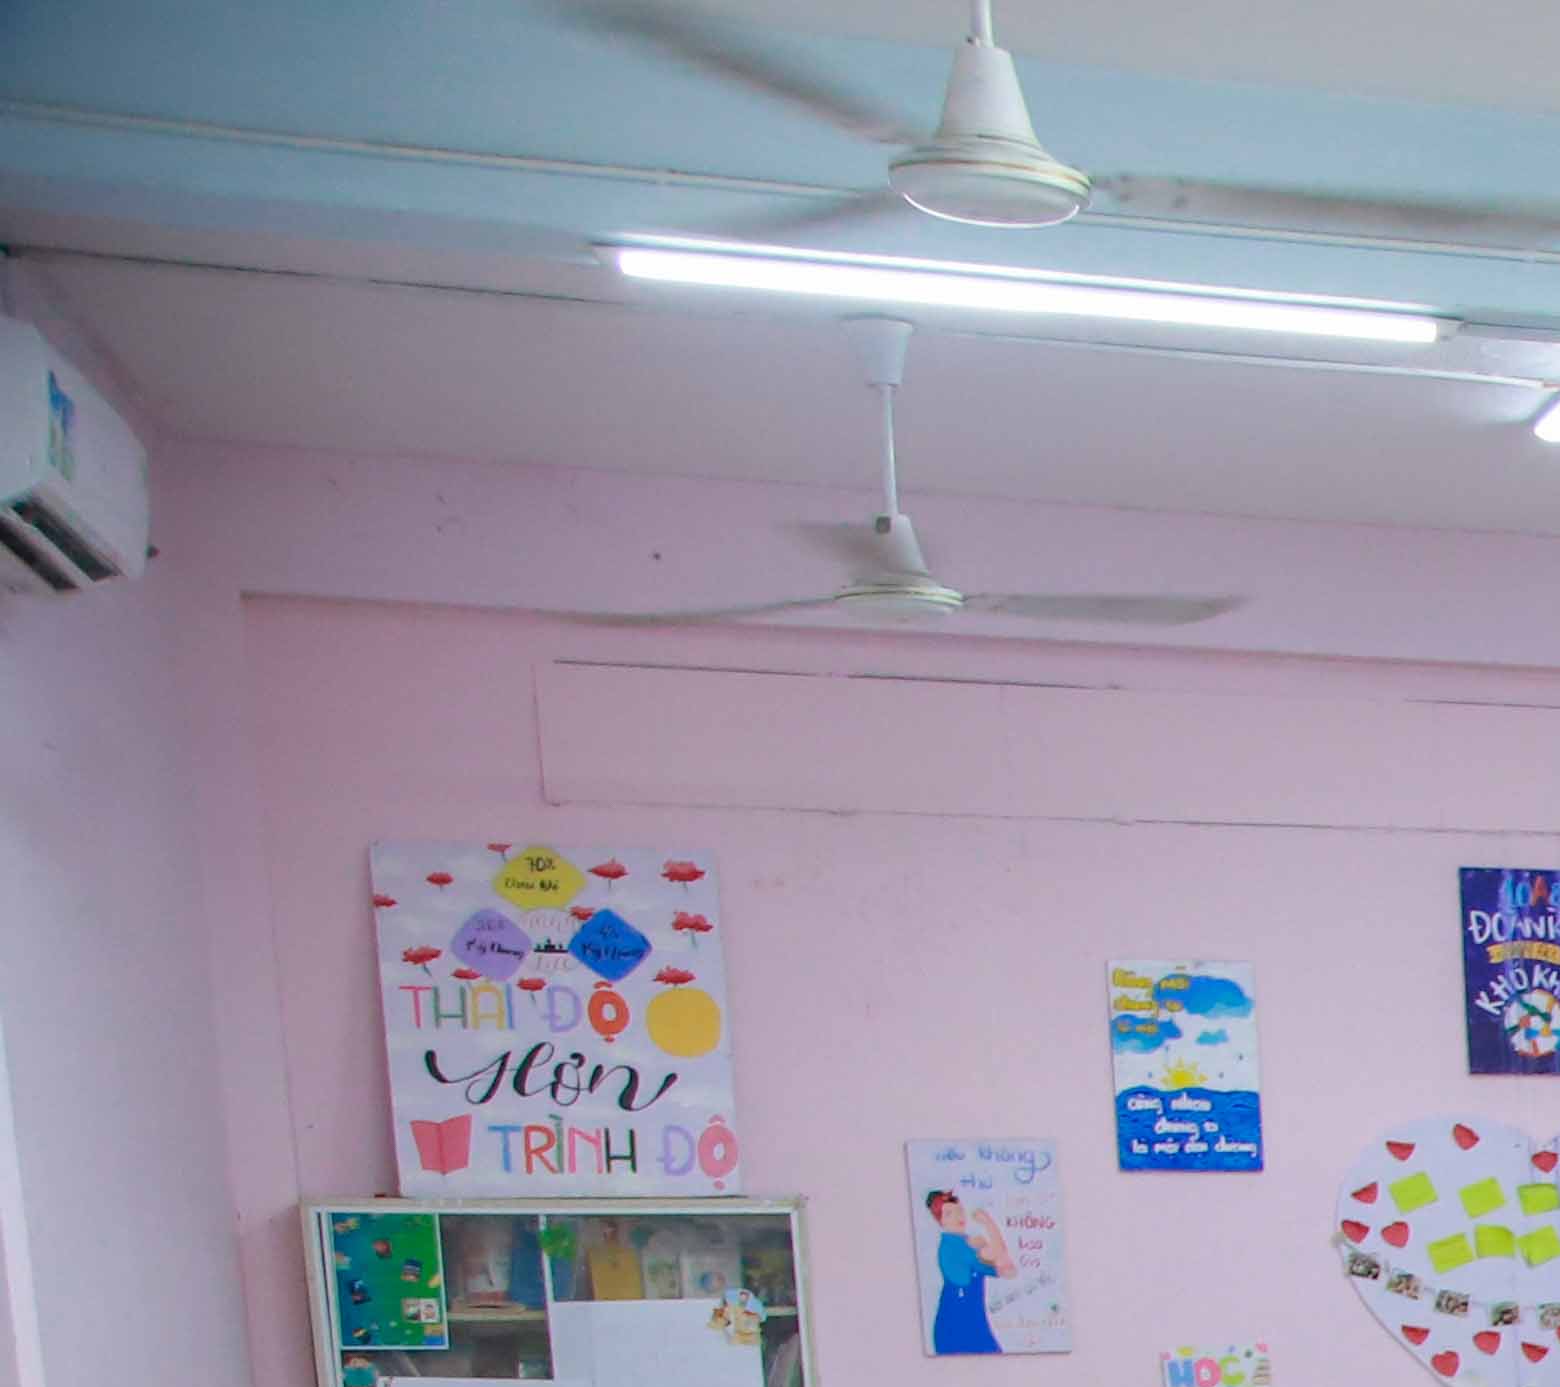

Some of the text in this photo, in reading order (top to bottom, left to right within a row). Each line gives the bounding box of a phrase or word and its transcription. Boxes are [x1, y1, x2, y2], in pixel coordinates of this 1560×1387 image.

[541, 981, 631, 1044] ĐỘ
[487, 1113, 739, 1190] TRÌNH ĐỘ
